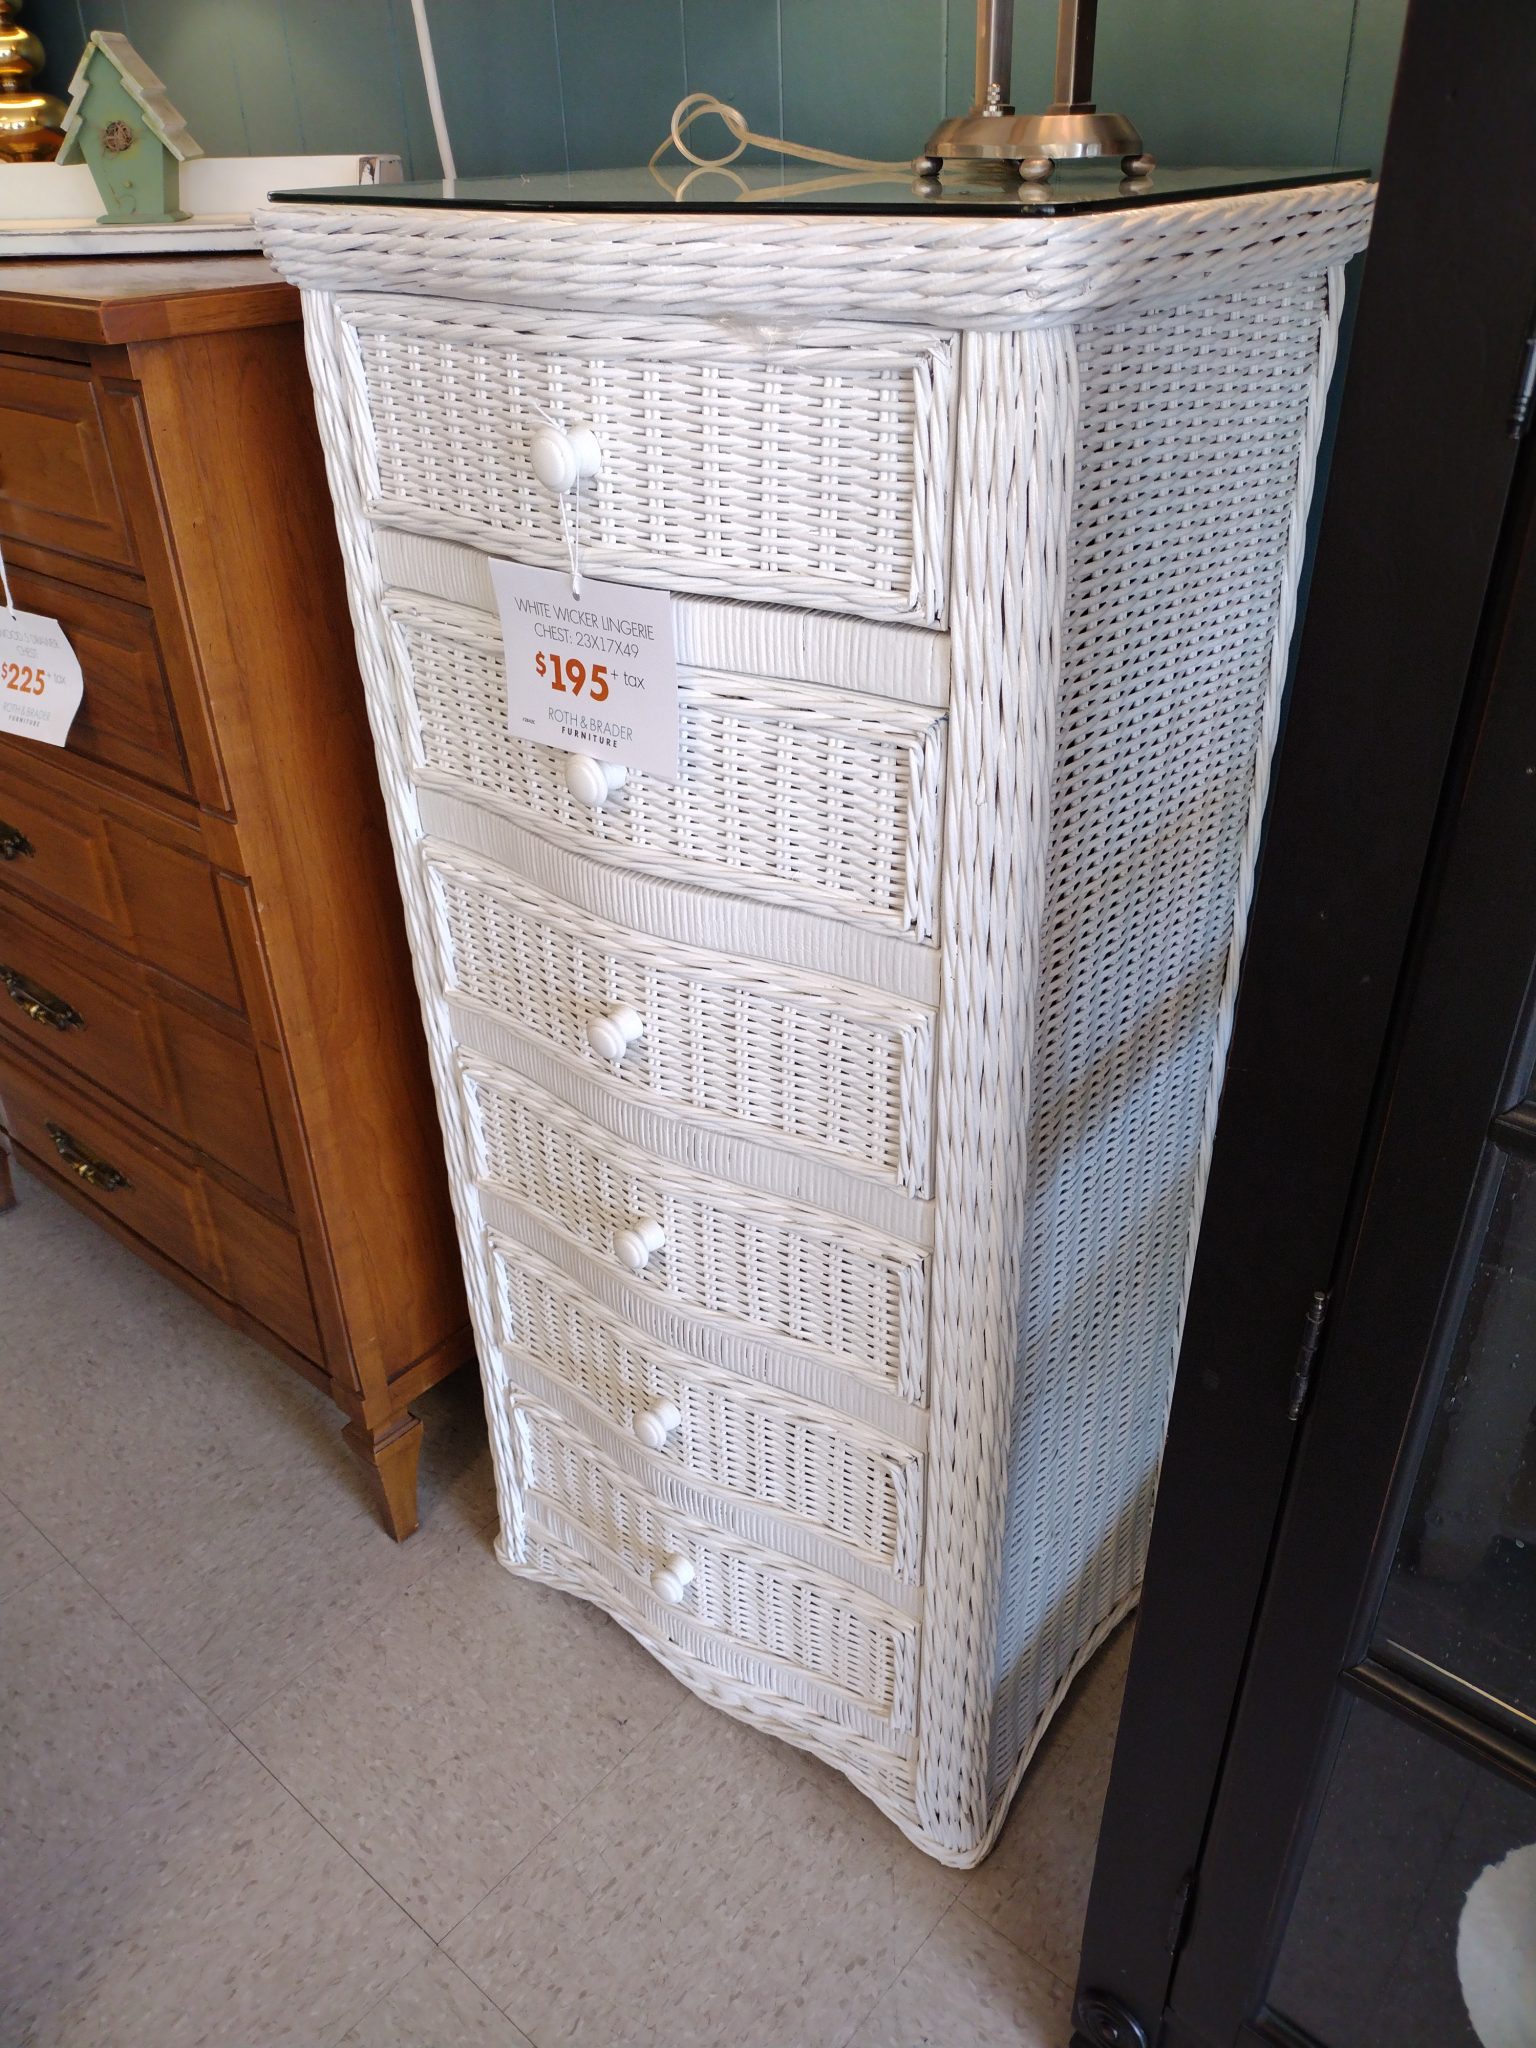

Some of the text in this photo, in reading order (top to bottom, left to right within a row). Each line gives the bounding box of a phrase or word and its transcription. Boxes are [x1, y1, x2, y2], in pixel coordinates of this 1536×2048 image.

[514, 597, 655, 641] WHITE WICKER LINGERIE
[534, 622, 640, 659] CHEST: 23X17X49
[1, 661, 46, 696] $225
[535, 650, 609, 702] $195
[623, 670, 646, 690] tax
[561, 726, 618, 748] FURNITURE
